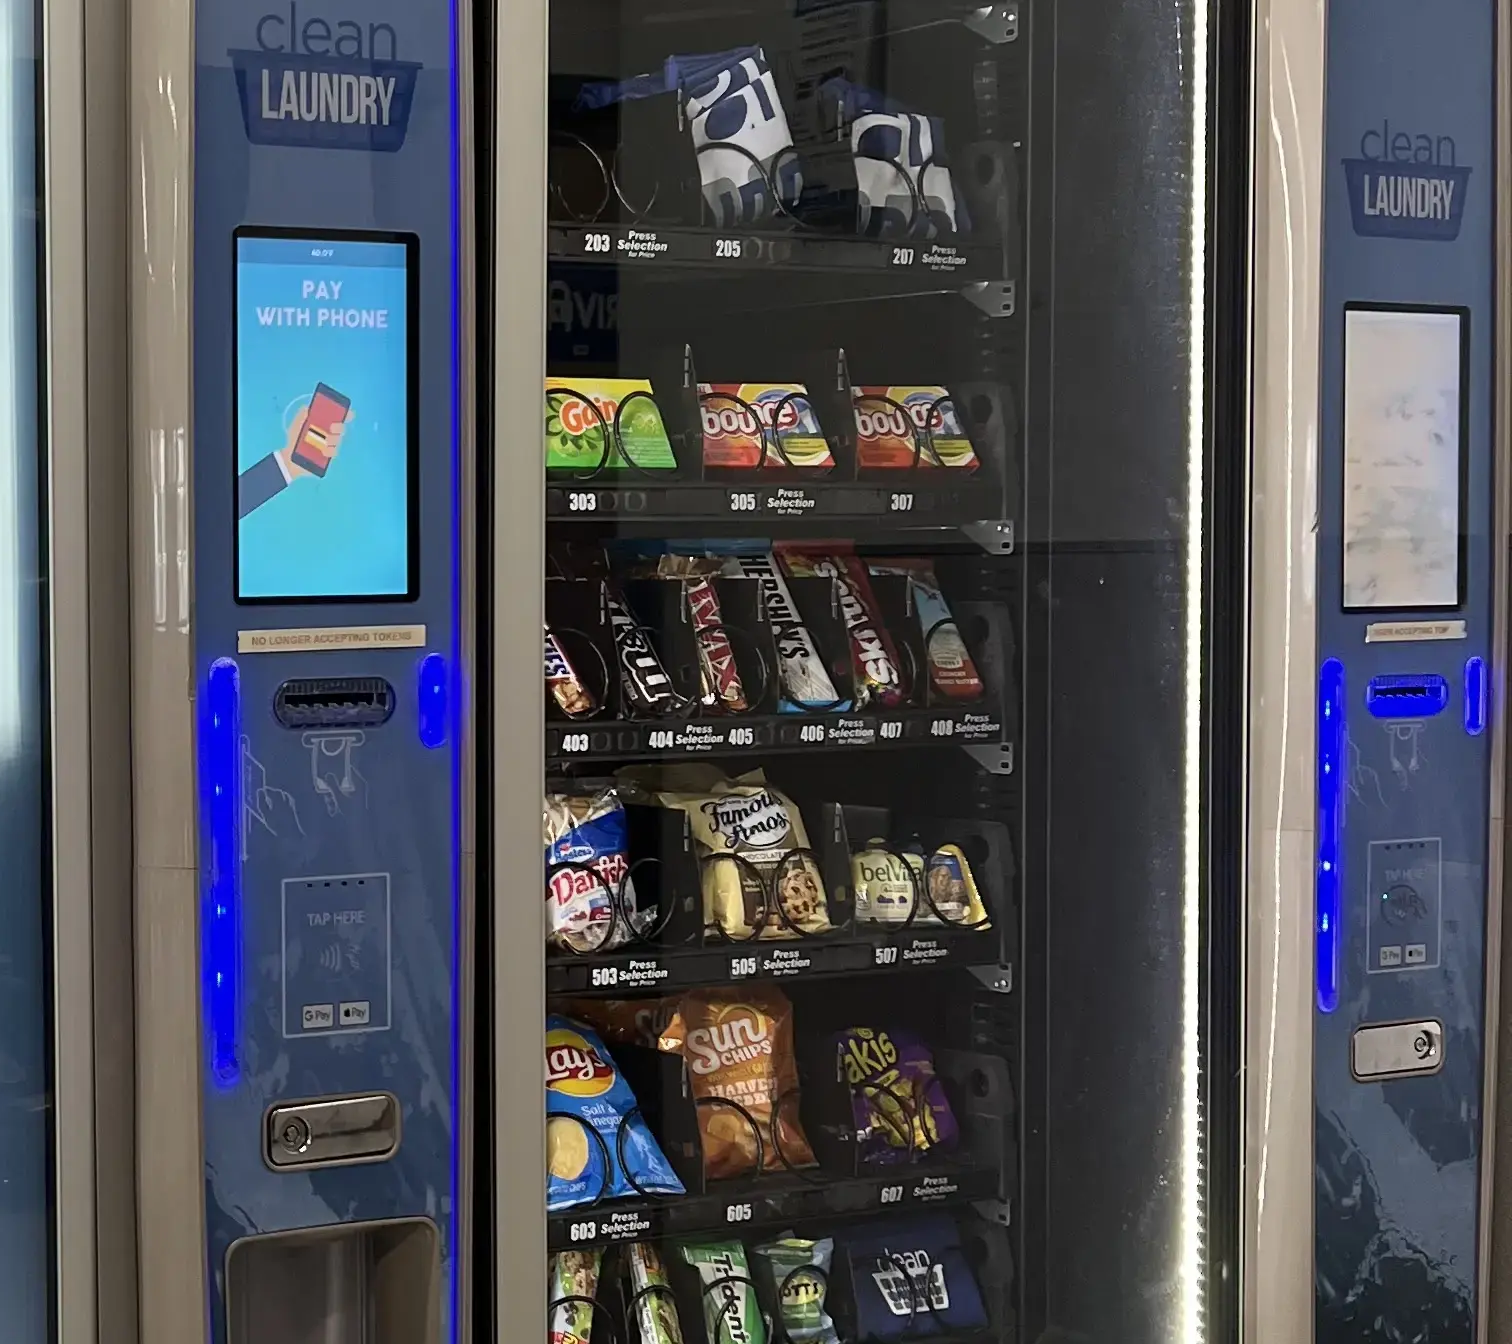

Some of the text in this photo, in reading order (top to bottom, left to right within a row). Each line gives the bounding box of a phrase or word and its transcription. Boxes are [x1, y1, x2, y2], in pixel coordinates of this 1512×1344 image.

[256, 0, 397, 59] clean
[261, 68, 396, 126] LAUNDRY
[1360, 119, 1456, 167] clean
[1363, 173, 1455, 219] LAUNDRY
[584, 234, 611, 253] 203
[628, 230, 657, 241] Press
[617, 239, 668, 253] Selection
[716, 240, 741, 258] 205
[893, 248, 914, 265] 207
[922, 253, 967, 266] Selection
[301, 280, 343, 299] PAY
[256, 306, 389, 329] WITH PHONE
[560, 397, 617, 432] Gain
[700, 399, 798, 438] bounce
[569, 492, 597, 512] 303
[731, 493, 756, 511] 305
[778, 488, 804, 499] Press
[891, 493, 913, 511] 307
[767, 496, 815, 510] Selection
[251, 631, 412, 646] NO LONGER ACCEPTING TOKENS
[686, 724, 713, 735] Press
[838, 718, 864, 728] Press
[879, 722, 903, 739] 407
[930, 719, 953, 736] 408
[955, 722, 1000, 733] Selection
[648, 731, 673, 749] 404
[675, 733, 724, 745] Selection
[728, 728, 754, 746] 405
[800, 725, 825, 742] 406
[828, 728, 874, 738] Selection
[562, 734, 589, 752] 403
[724, 811, 789, 848] Amos
[549, 855, 628, 907] Danish
[306, 911, 365, 926] TAP HERE
[773, 949, 800, 959] Press
[875, 947, 898, 964] 507
[629, 960, 657, 970] Press
[731, 958, 756, 975] 505
[763, 958, 811, 970] Selection
[592, 967, 618, 986] 503
[619, 969, 668, 981] Selection
[687, 1017, 768, 1075] Sun
[720, 1039, 773, 1066] CHIPS
[844, 1031, 897, 1084] akis
[580, 1104, 605, 1118] Salt
[880, 1185, 904, 1203] 607
[611, 1212, 638, 1223] Press
[726, 1204, 752, 1222] 605
[570, 1222, 597, 1242] 603
[601, 1220, 650, 1235] Selection
